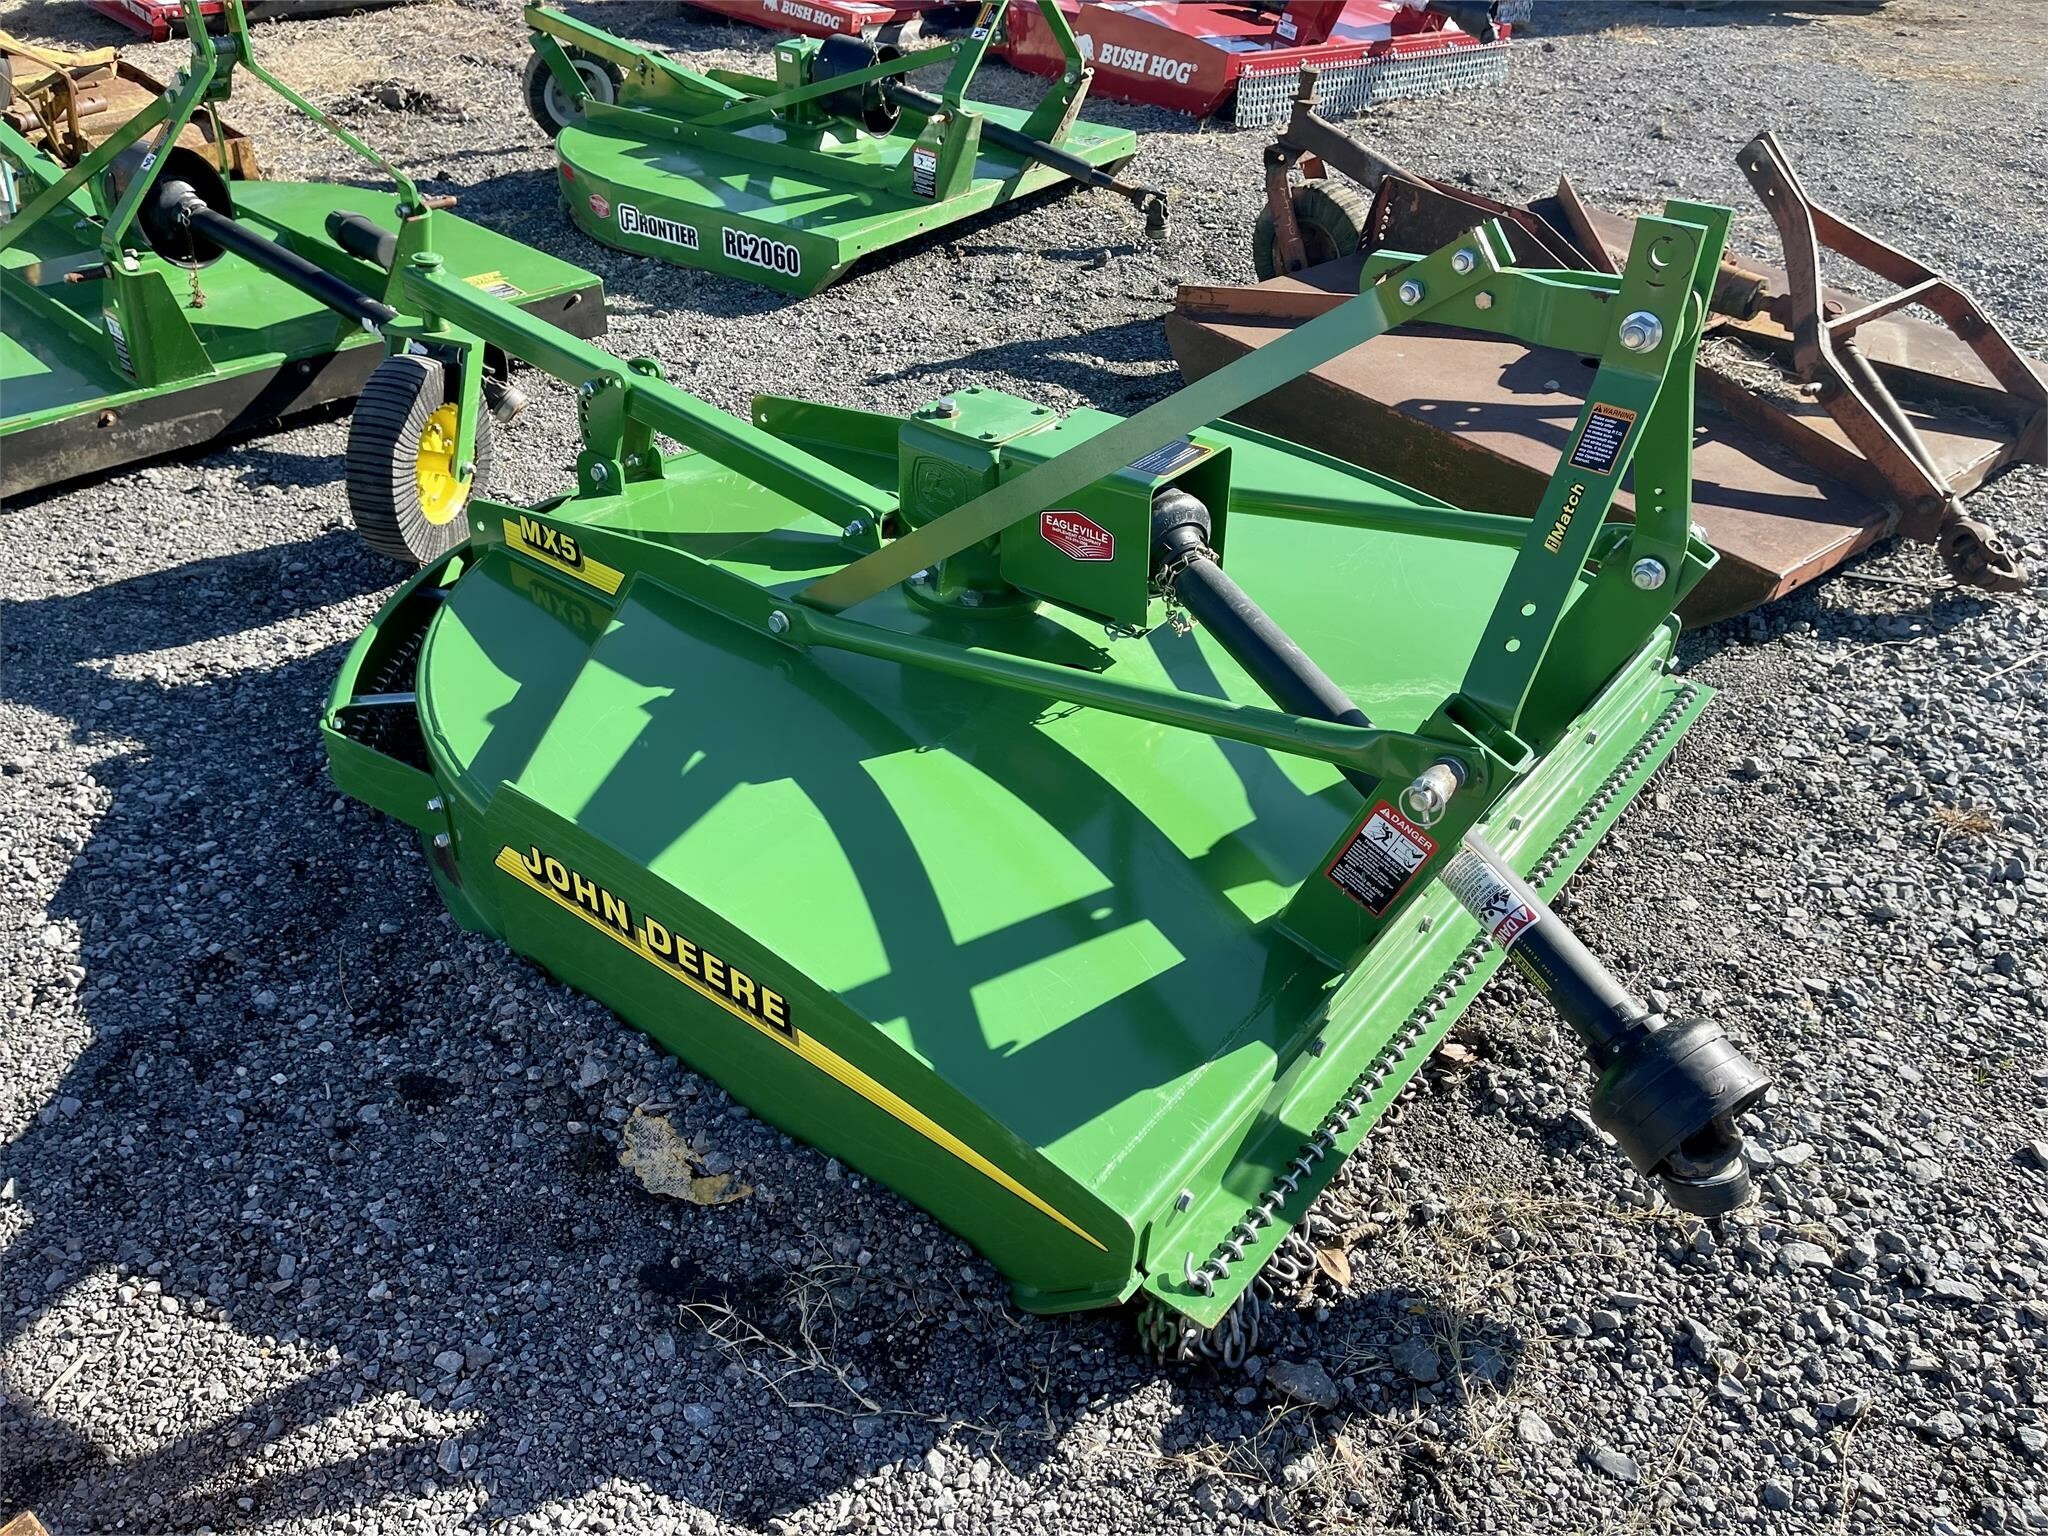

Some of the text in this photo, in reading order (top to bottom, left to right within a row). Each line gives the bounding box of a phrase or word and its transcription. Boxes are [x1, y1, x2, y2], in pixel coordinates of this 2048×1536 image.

[781, 0, 840, 30] BUSH HOG
[1098, 43, 1149, 73] BUSH
[619, 204, 698, 249] FRONTIER
[724, 228, 799, 275] RC2060
[1602, 406, 1634, 420] WARNING
[520, 514, 579, 564] MX5
[1046, 514, 1109, 544] EAGLEVILLE
[1390, 814, 1433, 851] DANGER
[522, 846, 789, 1029] JOHN DEERE
